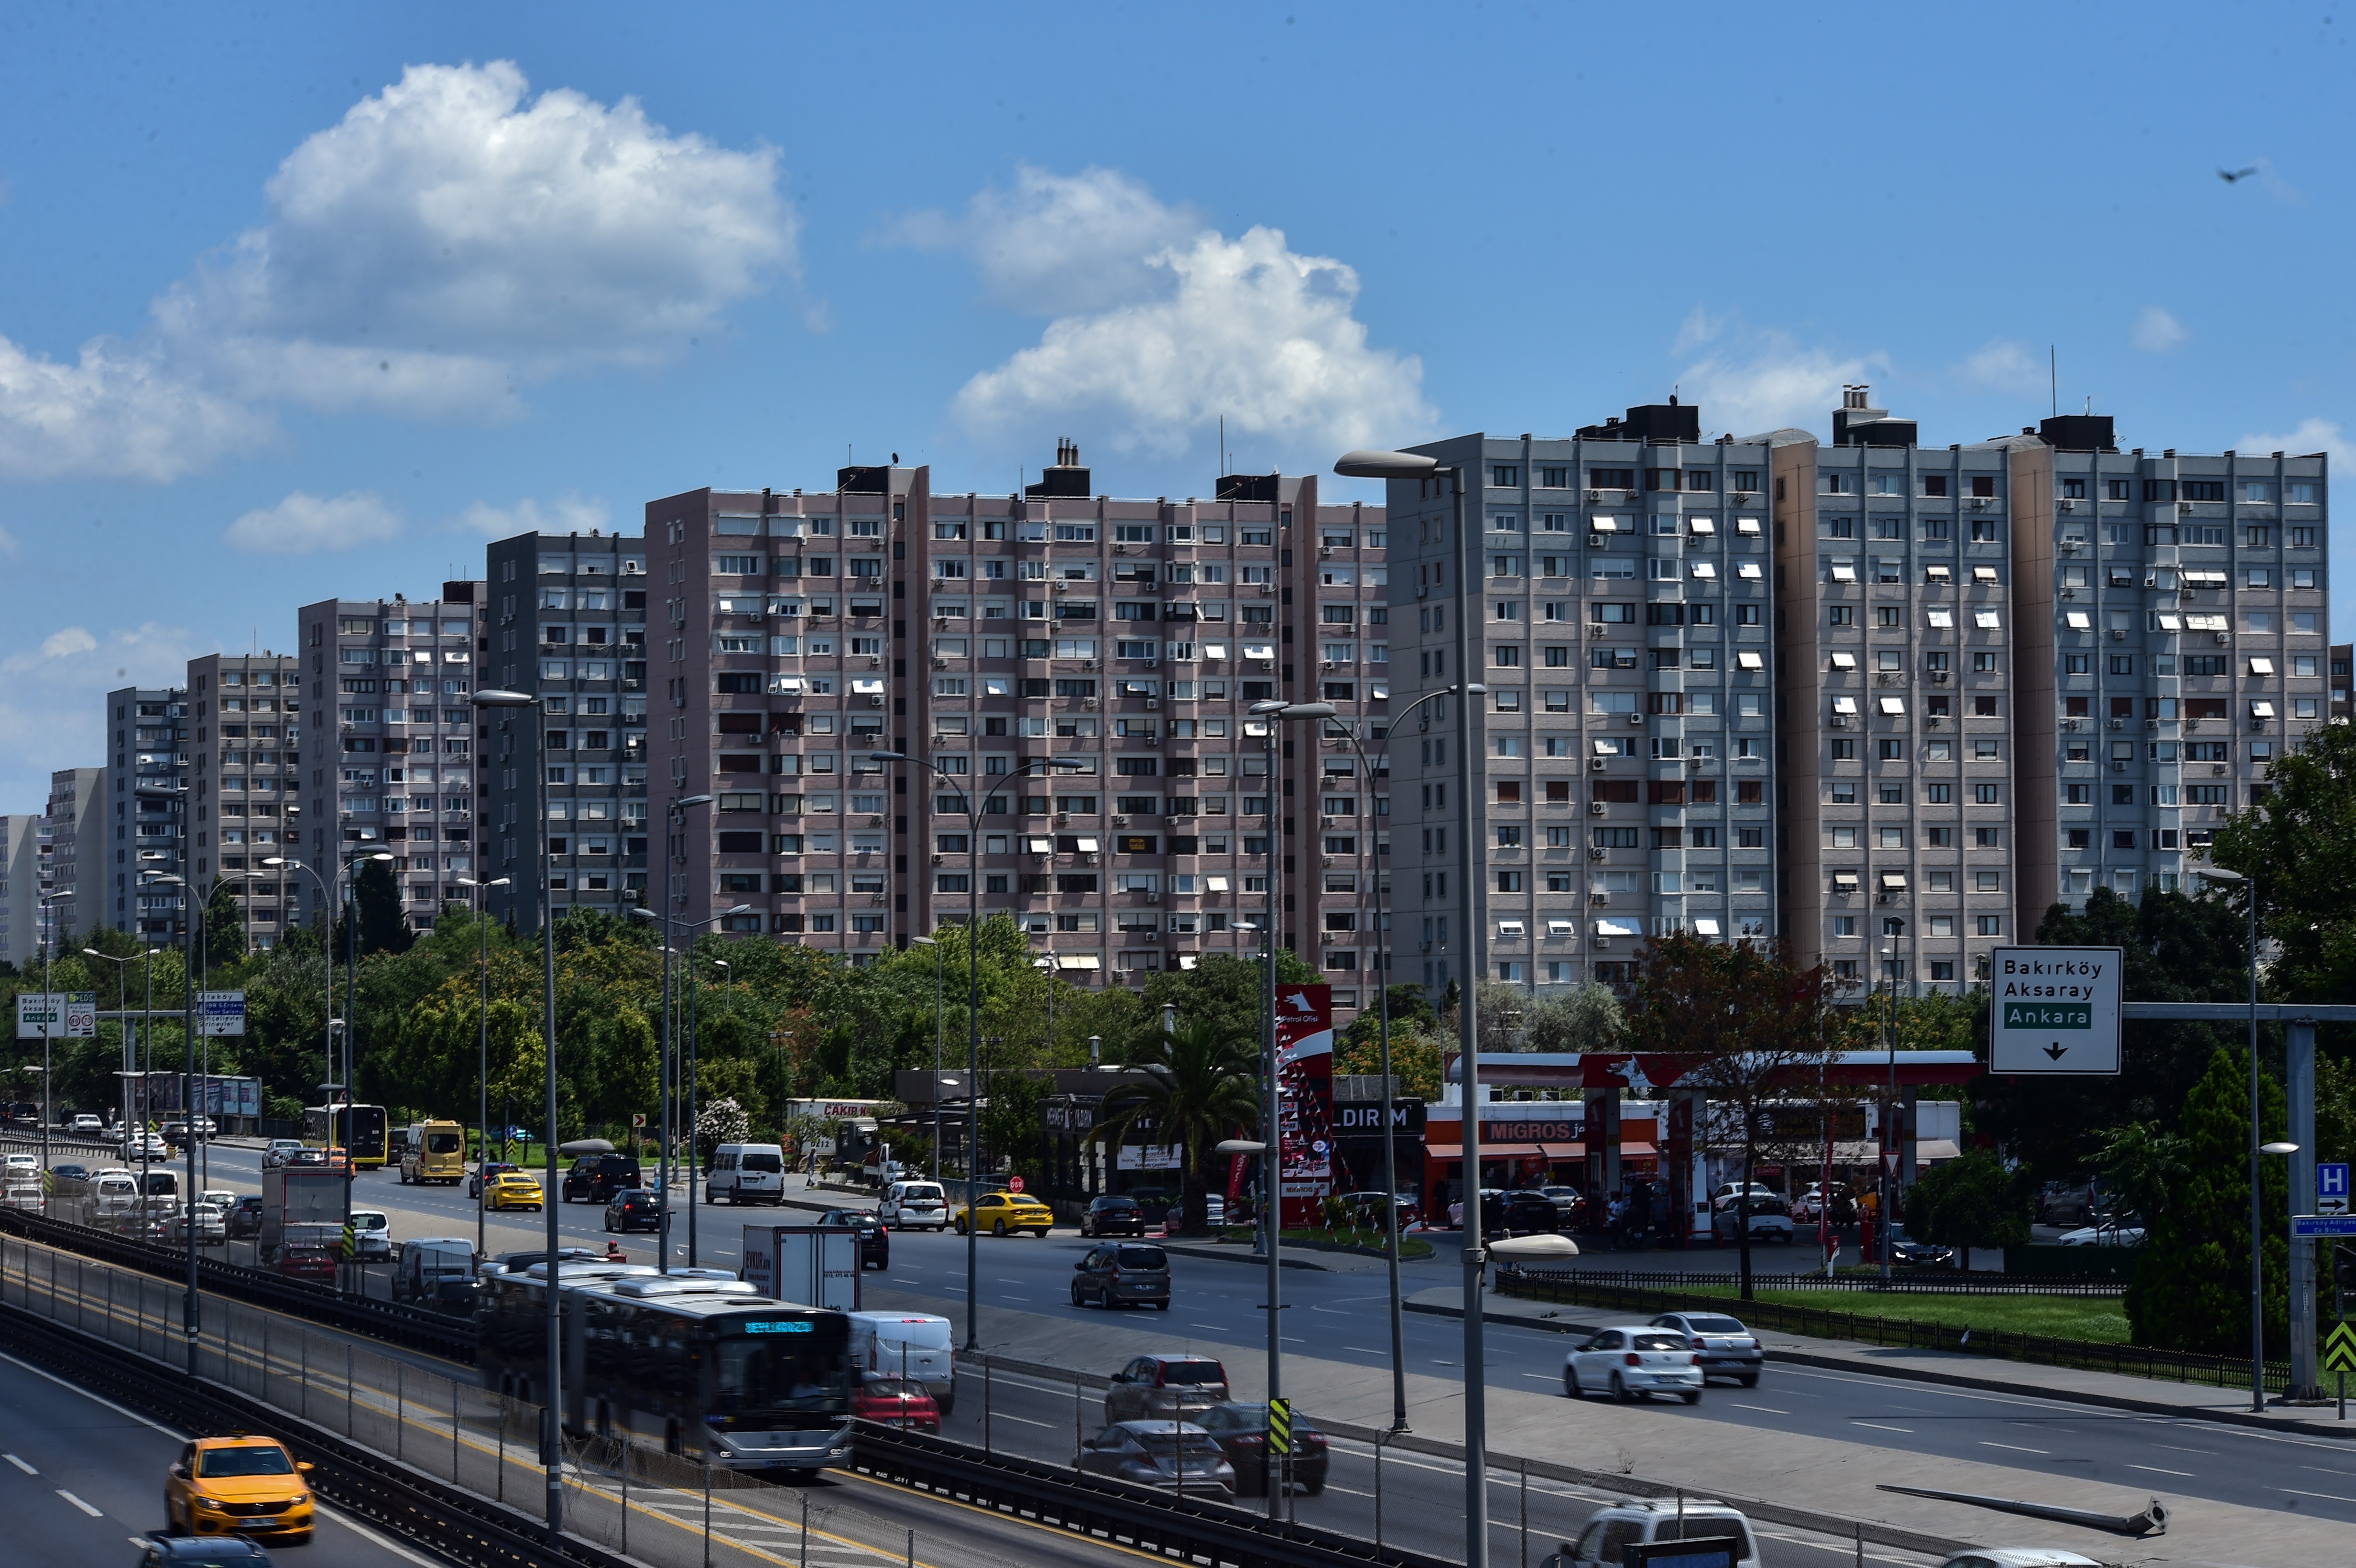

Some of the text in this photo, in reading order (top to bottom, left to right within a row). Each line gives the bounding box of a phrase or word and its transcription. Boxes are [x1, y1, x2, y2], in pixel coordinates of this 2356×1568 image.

[2005, 960, 2102, 979] Bakırköy
[2004, 982, 2093, 1001] Aksaray
[2009, 1008, 2087, 1023] Ankara
[2323, 1169, 2342, 1192] H
[746, 1251, 763, 1270] EVKUR
